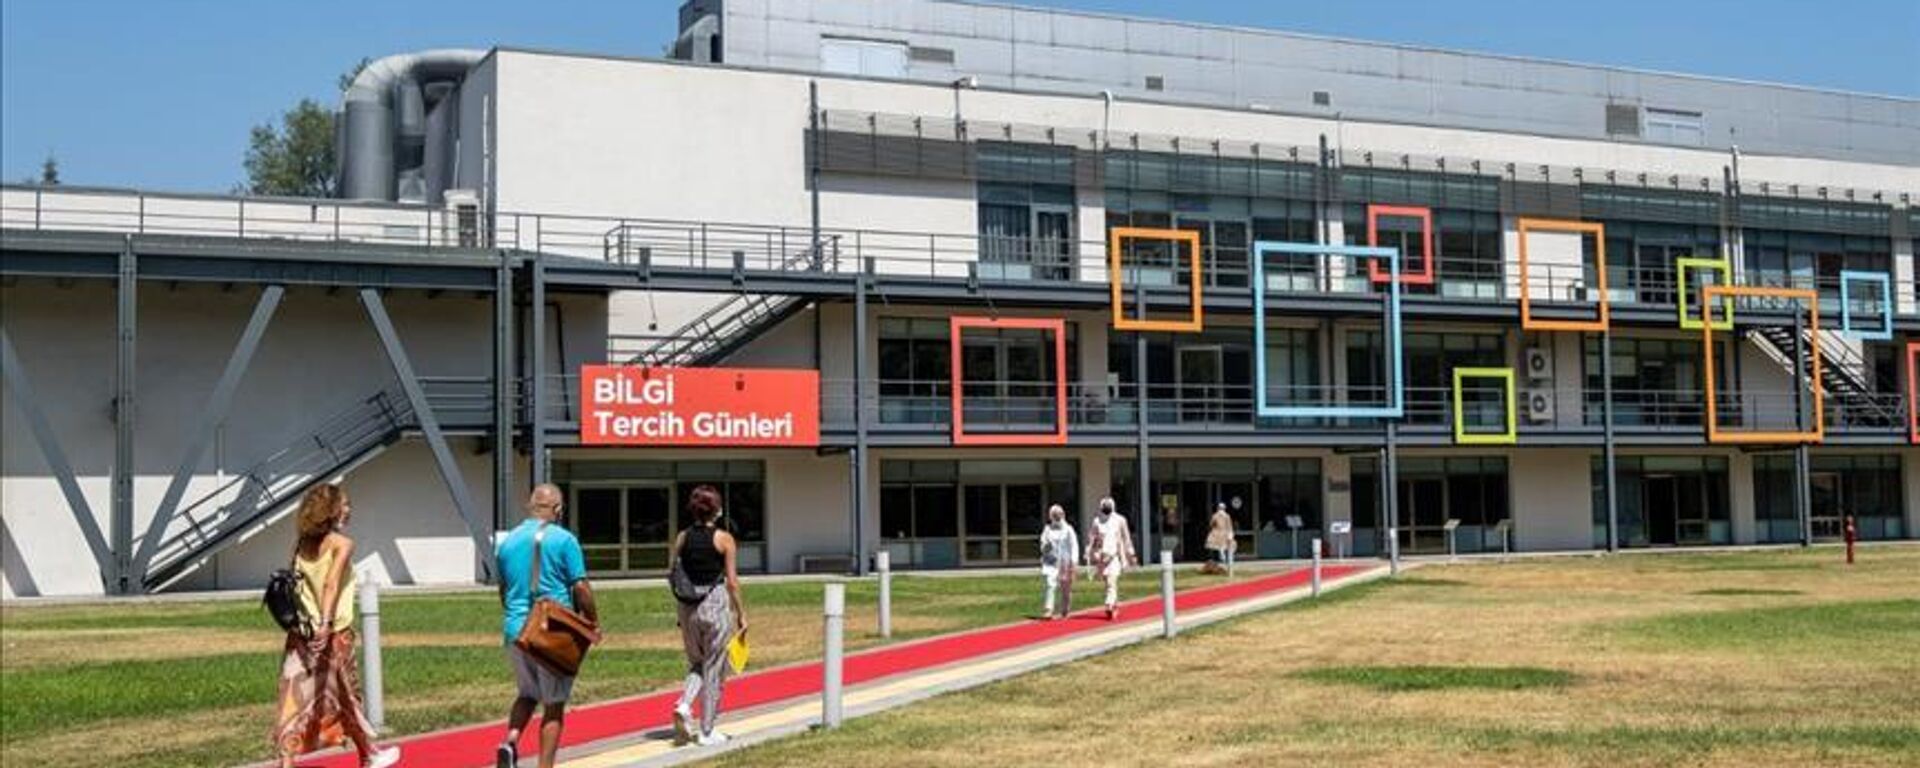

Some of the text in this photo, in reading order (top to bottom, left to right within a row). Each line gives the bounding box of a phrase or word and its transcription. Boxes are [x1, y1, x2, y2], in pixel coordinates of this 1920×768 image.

[594, 374, 674, 404] BİLGİ
[593, 411, 793, 438] Tercih Günleri
